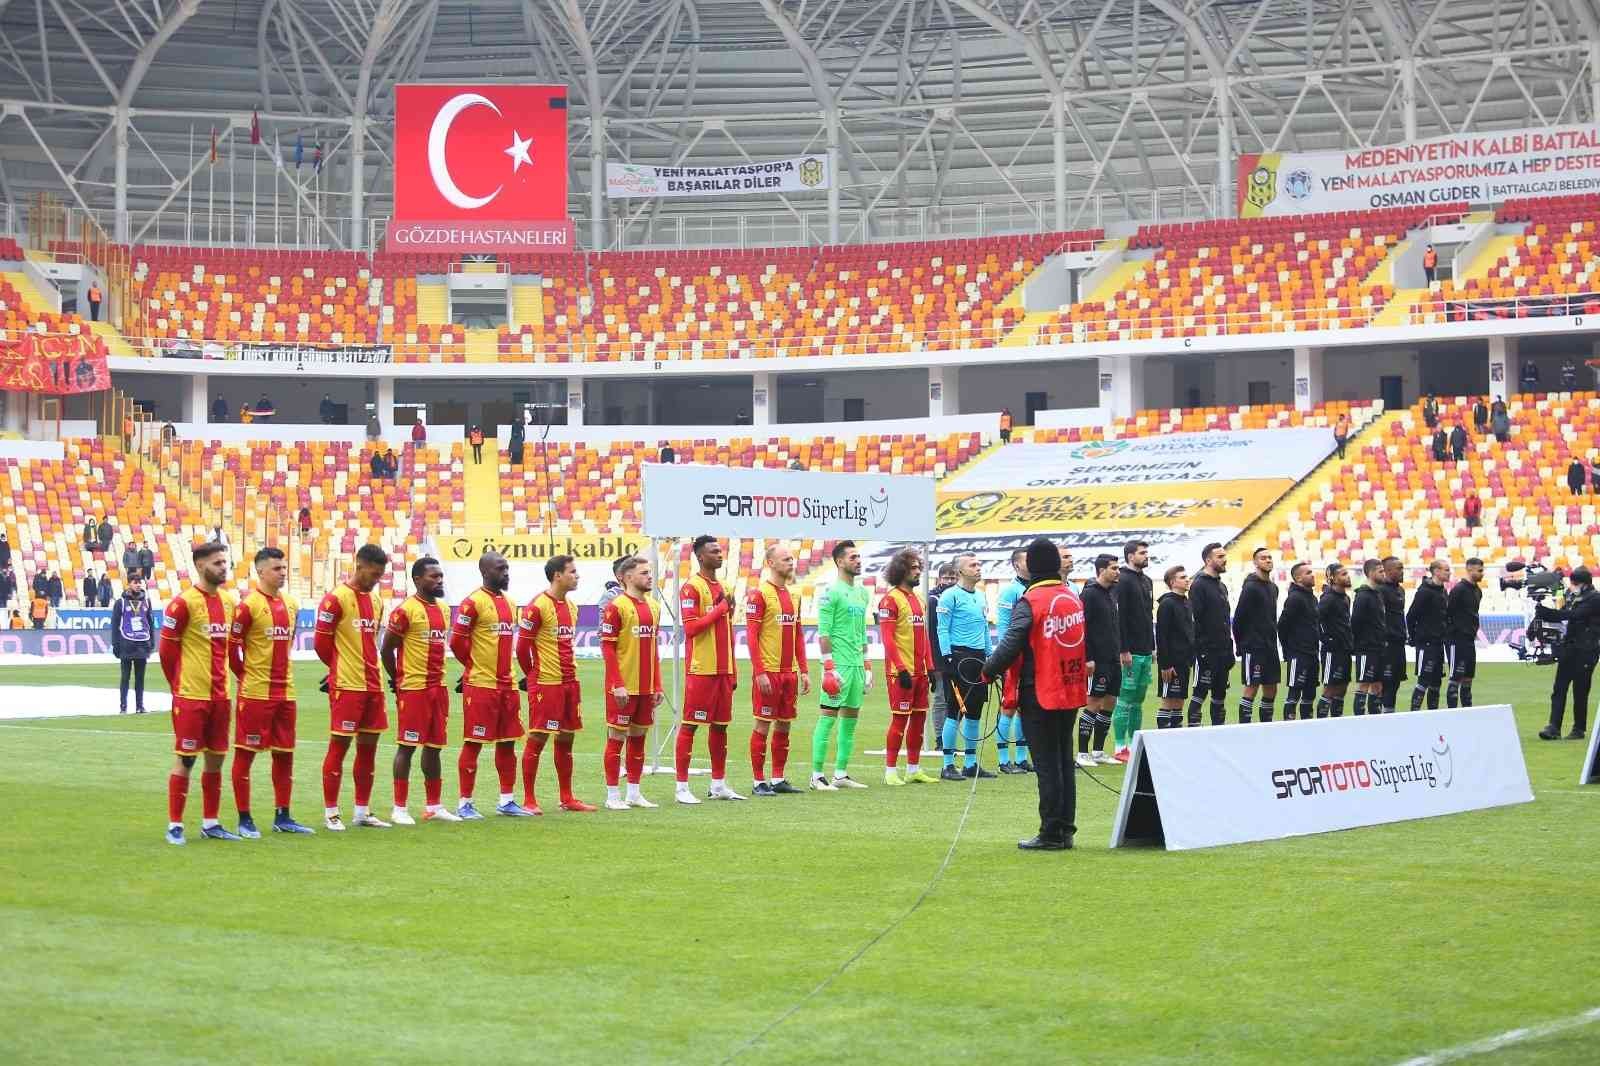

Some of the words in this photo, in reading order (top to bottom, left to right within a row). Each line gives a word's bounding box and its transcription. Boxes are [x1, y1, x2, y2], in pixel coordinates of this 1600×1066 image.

[1345, 139, 1468, 169] MEDENİYETİN
[1473, 134, 1528, 156] KALBİ
[654, 167, 684, 177] YENİ
[687, 161, 794, 177] MALATYASPOR'A
[1321, 174, 1354, 191] YENİ
[1522, 158, 1551, 173] HEP
[668, 178, 740, 193] BAŞARILAR
[744, 176, 781, 189] DİLER
[1493, 181, 1557, 196] BATTALGAZİ
[1370, 190, 1425, 207] OSMAN
[1429, 185, 1480, 202] GÜDER
[1575, 316, 1583, 326] D
[1184, 338, 1192, 348] C
[654, 361, 662, 370] B
[482, 538, 560, 558] öznur
[567, 537, 639, 557] kablo
[56, 616, 111, 630] MEDIC
[1043, 610, 1086, 639] Bilyone
